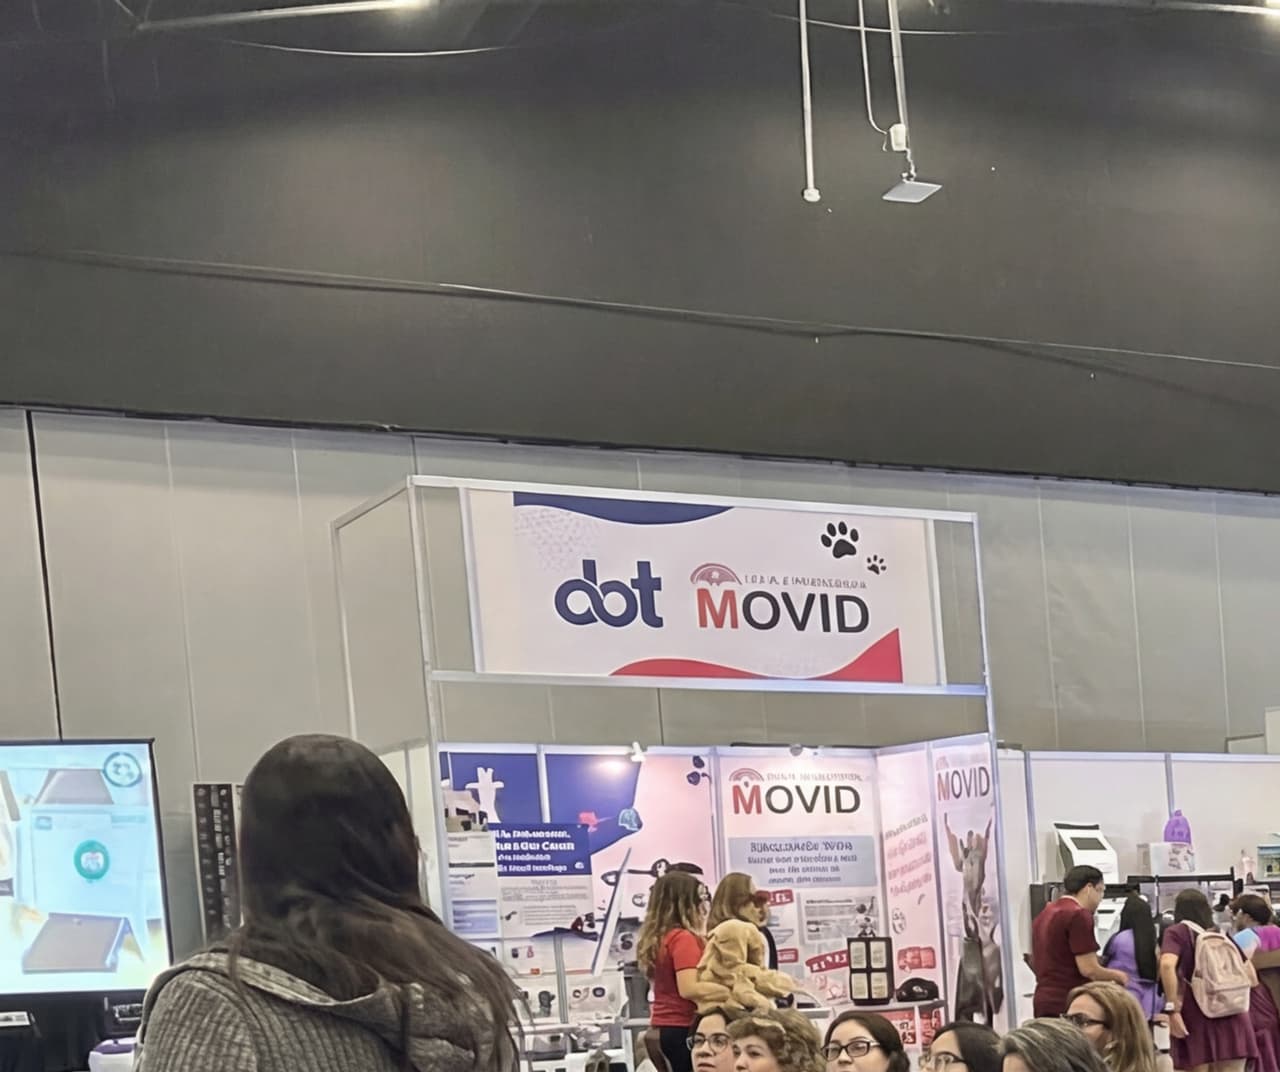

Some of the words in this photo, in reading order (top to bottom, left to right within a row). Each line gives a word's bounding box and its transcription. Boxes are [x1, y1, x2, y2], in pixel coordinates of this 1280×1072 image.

[555, 559, 664, 628] dot
[697, 587, 870, 634] MOVID
[732, 784, 861, 815] MOVID
[937, 765, 991, 802] MOVID
